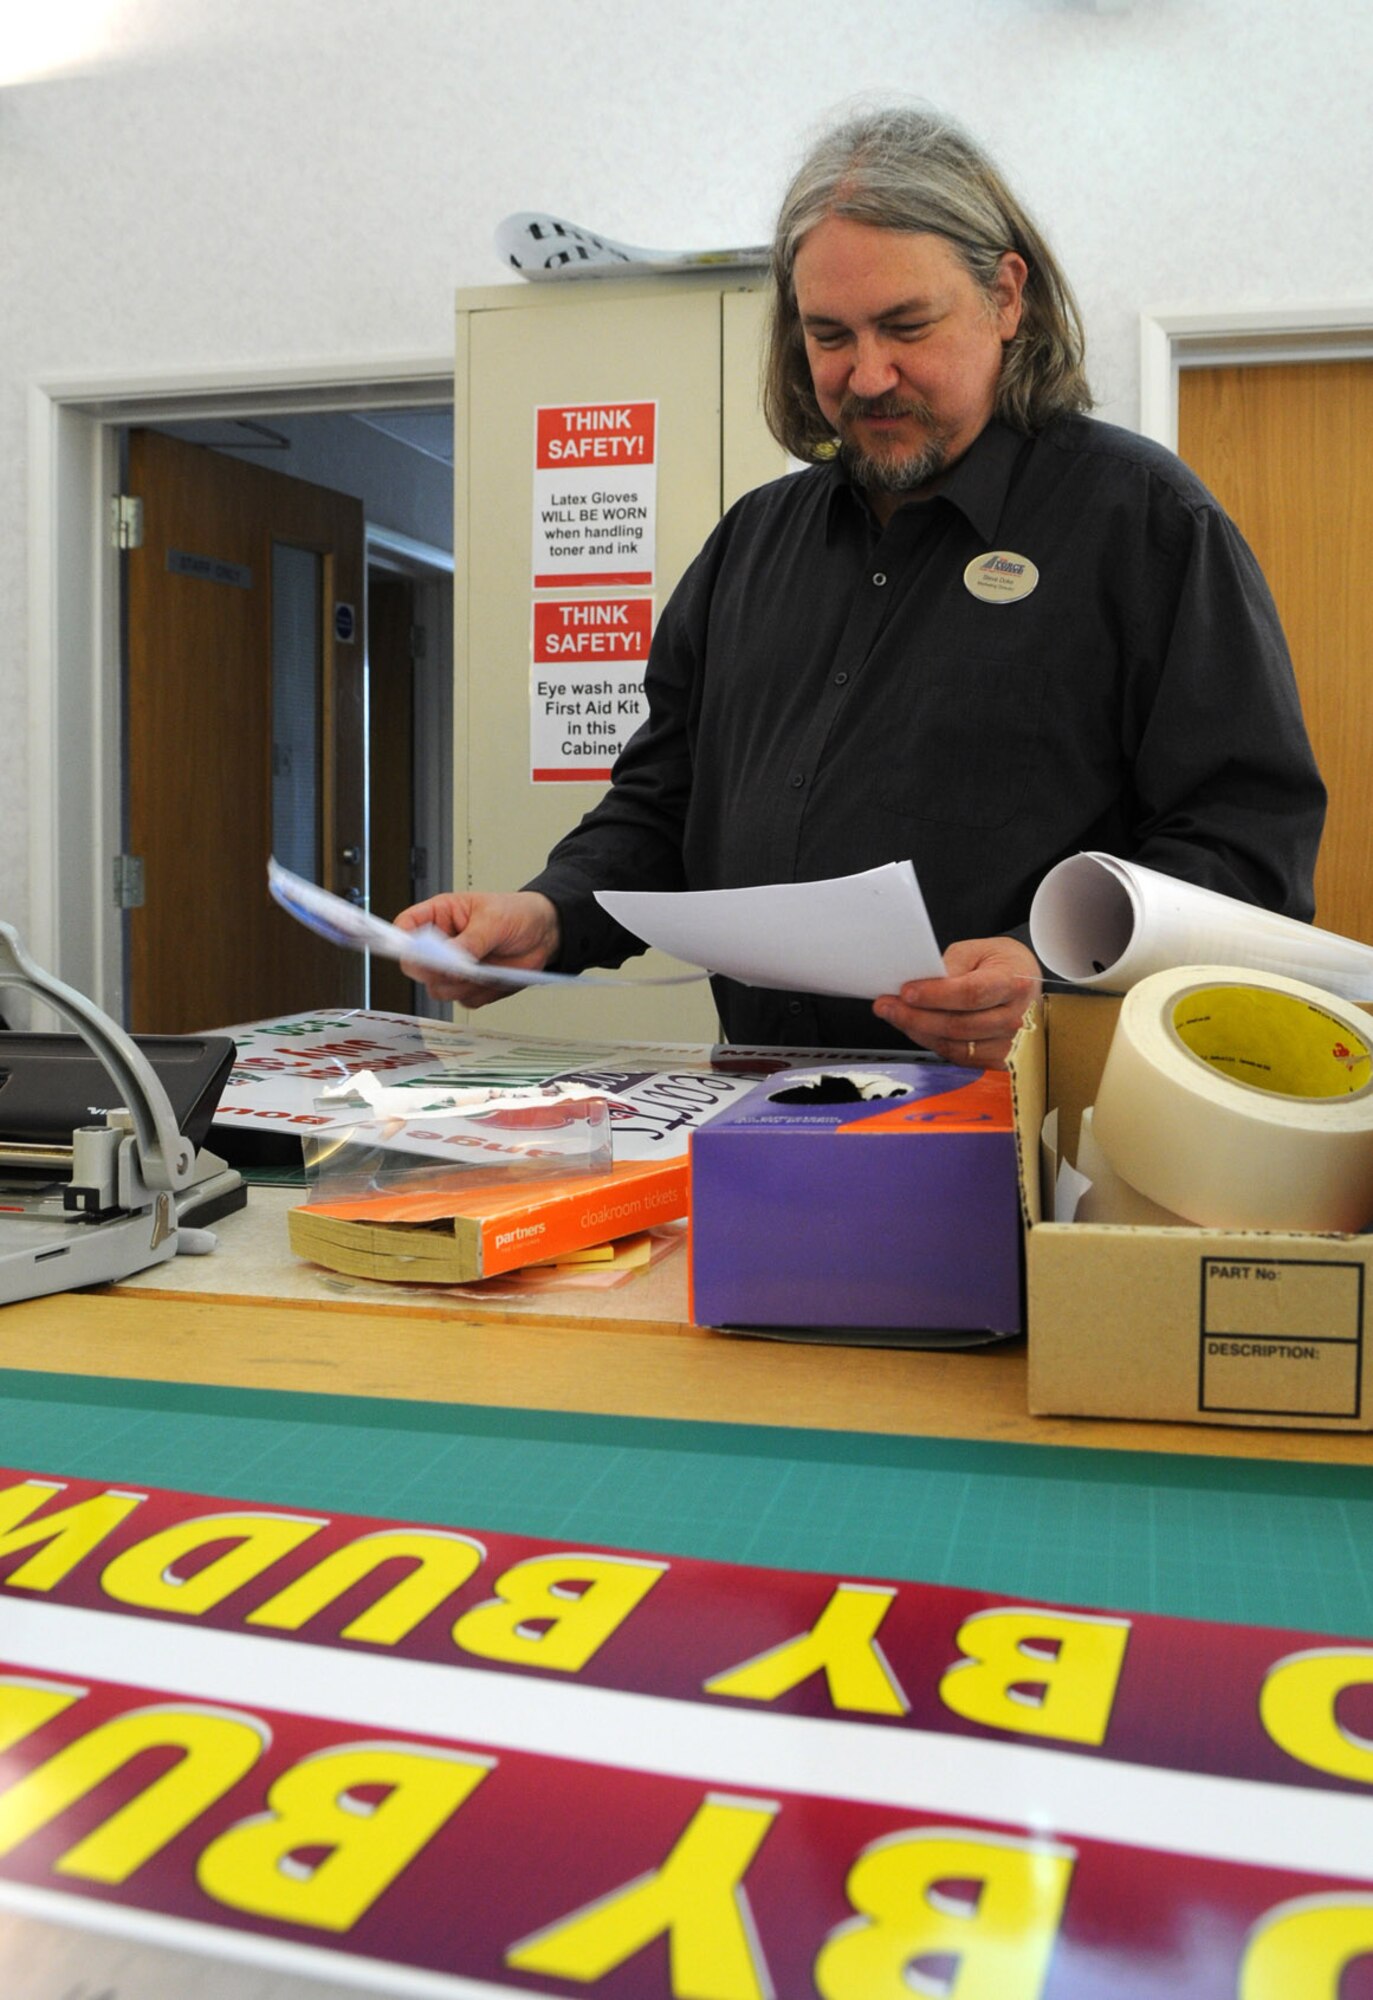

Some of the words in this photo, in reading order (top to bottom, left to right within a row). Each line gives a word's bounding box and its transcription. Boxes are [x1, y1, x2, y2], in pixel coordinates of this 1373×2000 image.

[562, 409, 632, 431] THINK
[548, 436, 644, 459] SAFETY!
[551, 494, 587, 506] Latex
[591, 492, 638, 505] Gloves
[541, 511, 575, 523] WILL
[580, 509, 598, 522] BE
[602, 507, 647, 521] WORN
[545, 528, 580, 540] when
[585, 525, 643, 540] handling
[549, 545, 585, 557] toner
[588, 543, 613, 556] and
[617, 541, 638, 554] ink
[559, 605, 629, 626] THINK
[546, 632, 641, 653] SAFETY!
[538, 682, 566, 699] Eye
[571, 681, 613, 694] wash
[545, 702, 581, 715] First
[585, 701, 612, 715] Aid
[617, 700, 640, 714] Kit
[567, 721, 581, 735] in
[587, 721, 616, 735] this
[561, 741, 623, 755] Cabinet
[495, 1222, 546, 1249] partners
[580, 1200, 642, 1228] cloakroom
[644, 1189, 679, 1210] tickets
[1210, 1265, 1251, 1279] PART
[1208, 1342, 1320, 1360] DESCRIPTION:
[703, 1583, 1132, 1747] BY
[0, 1675, 499, 1932] BU
